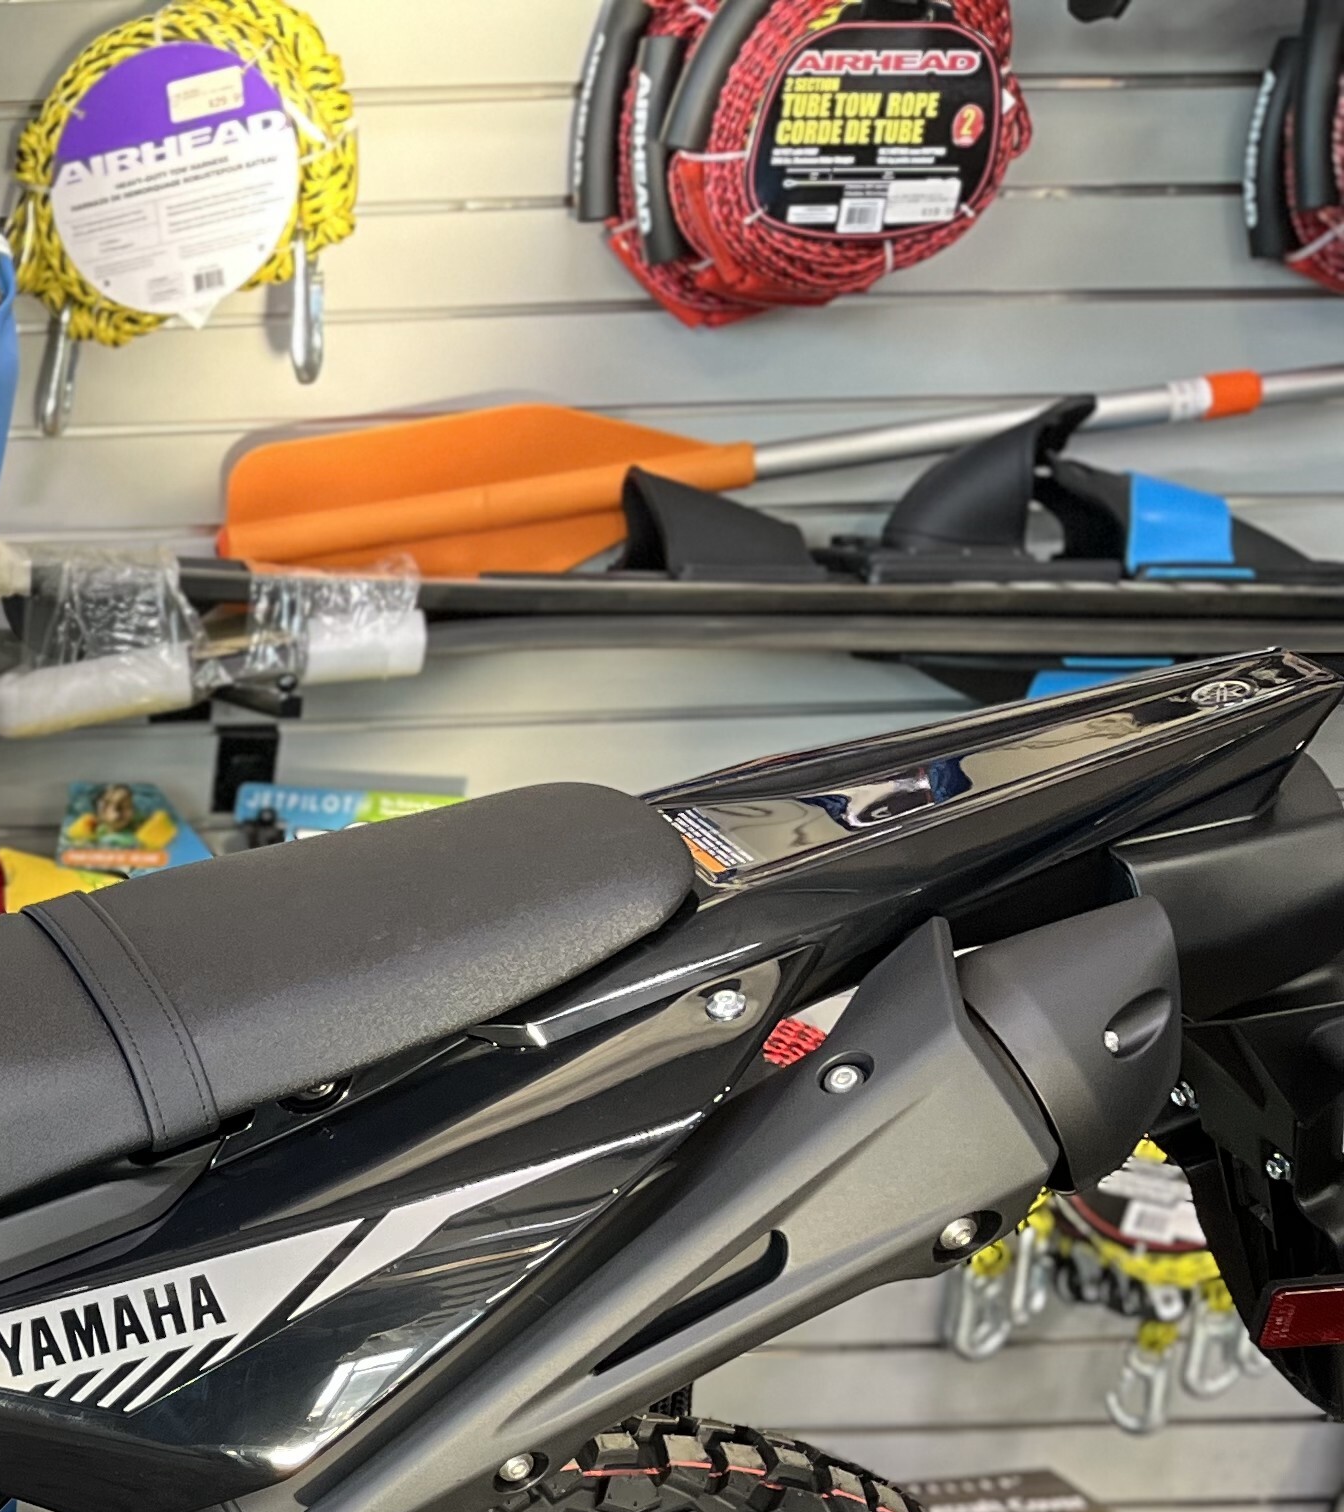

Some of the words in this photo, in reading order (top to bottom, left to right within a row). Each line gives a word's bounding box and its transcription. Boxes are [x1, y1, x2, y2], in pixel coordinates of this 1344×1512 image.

[787, 50, 980, 75] AIRHEAD
[783, 78, 794, 92] 2
[794, 77, 841, 92] SECTION
[782, 92, 832, 118] TUBE
[834, 92, 882, 118] TOW
[886, 92, 941, 118] ROPE
[774, 119, 844, 145] CORDE
[844, 119, 872, 144] DE
[873, 119, 926, 144] TUBE
[960, 108, 976, 137] 2
[52, 110, 290, 190] AIRHEAD
[634, 71, 652, 235] AIRHEAD
[246, 789, 354, 813] JETPILOT
